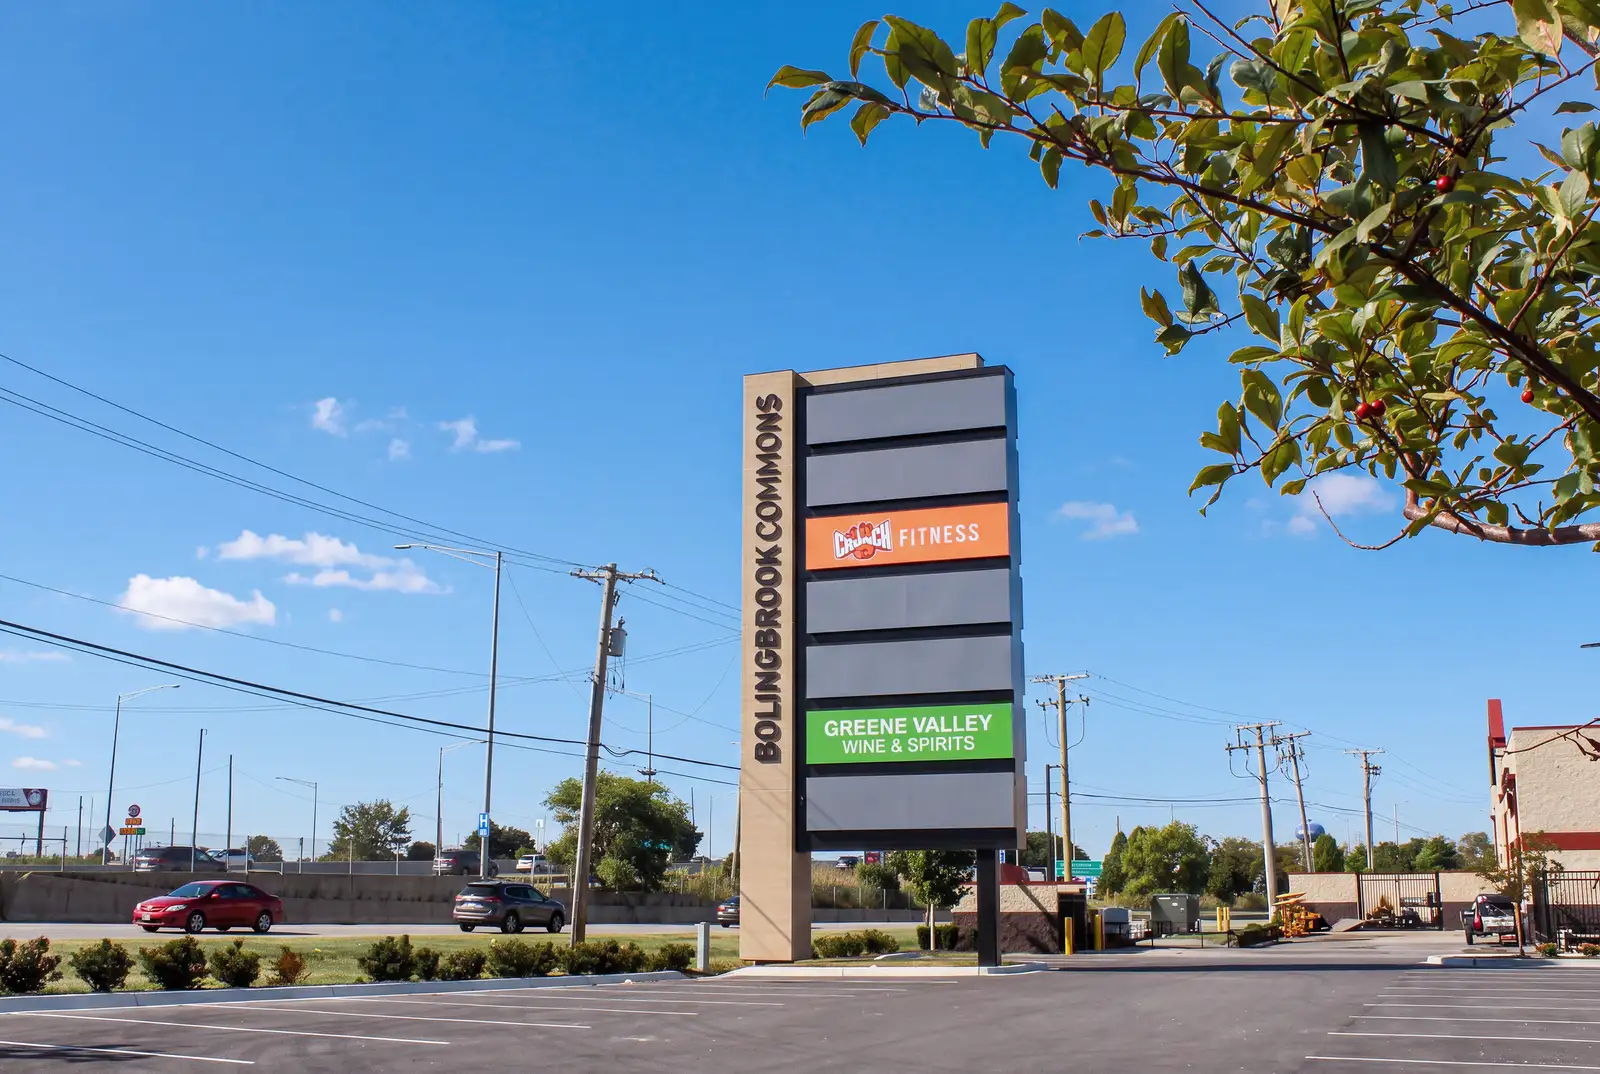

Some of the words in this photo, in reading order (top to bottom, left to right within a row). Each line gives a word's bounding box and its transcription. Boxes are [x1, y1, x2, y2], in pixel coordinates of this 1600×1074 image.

[755, 393, 783, 542] COMMONS
[833, 519, 893, 559] CRUNCH
[899, 523, 979, 547] FITNESS
[754, 544, 782, 764] BOLINGBROOK
[824, 717, 907, 737] GREENE
[912, 714, 993, 733] VALLEY
[842, 739, 886, 754] WINE
[890, 738, 902, 753] &
[907, 736, 975, 752] SPIRITS
[480, 814, 488, 828] H
